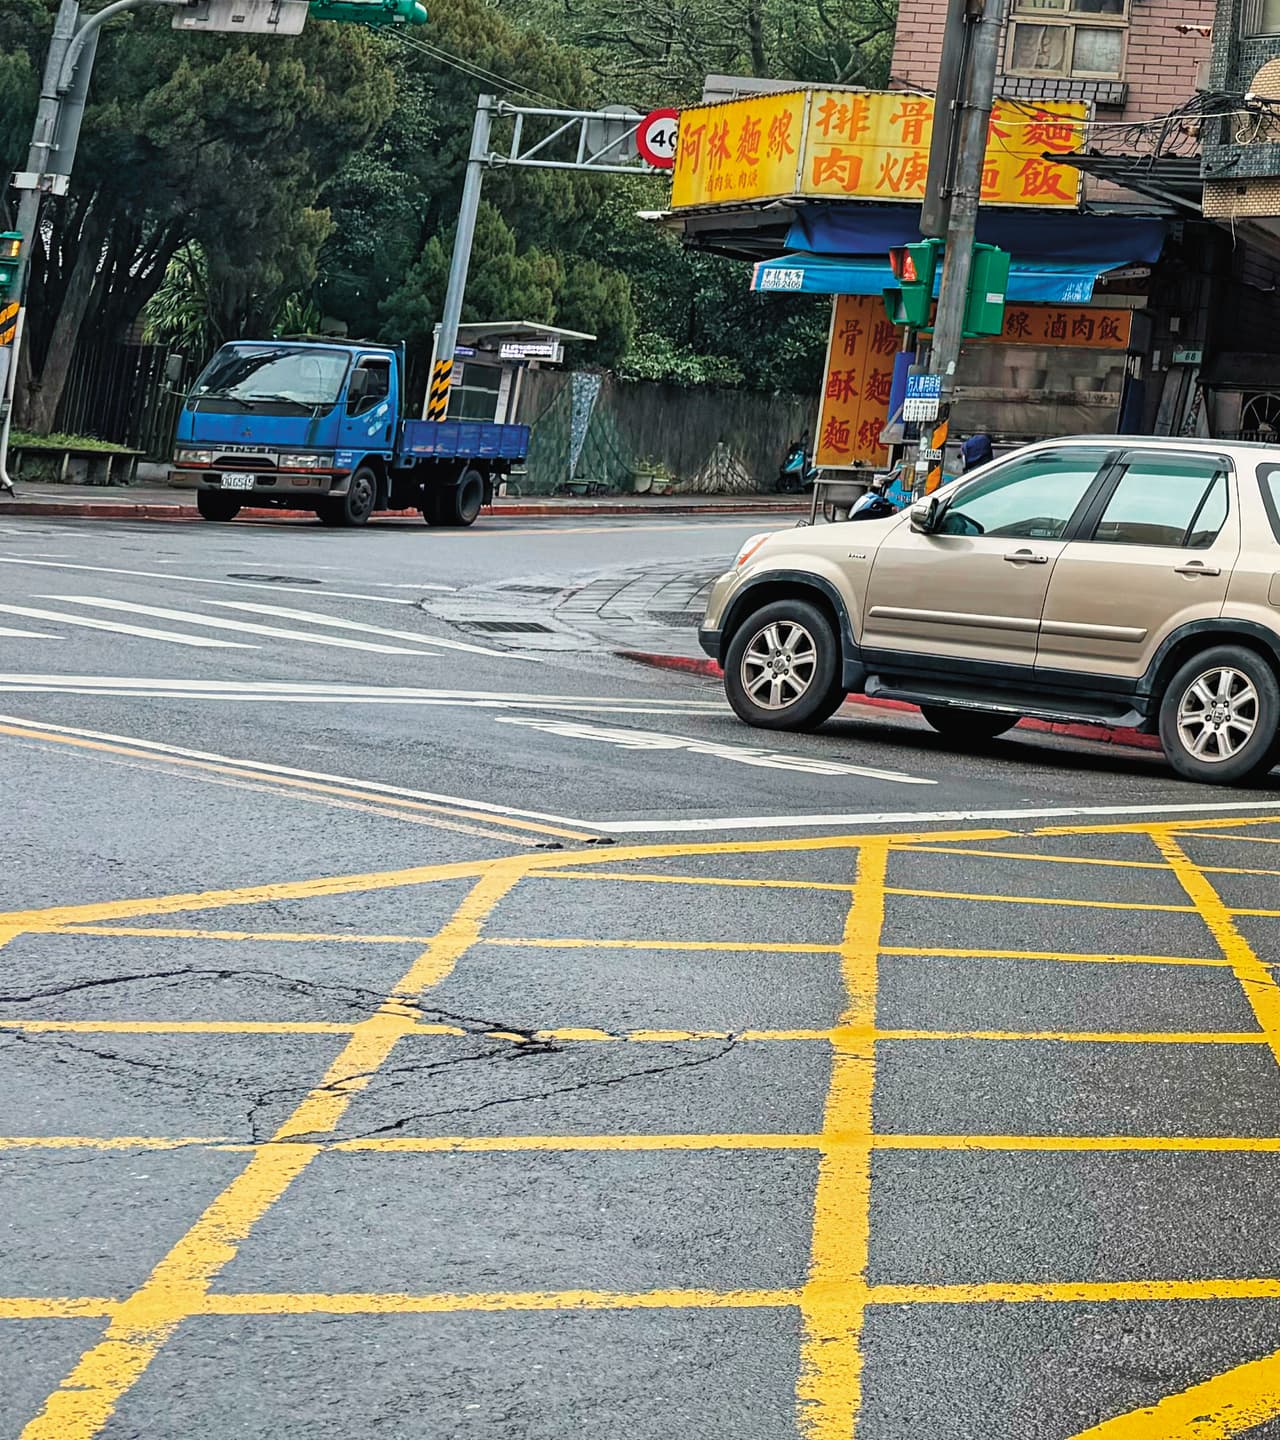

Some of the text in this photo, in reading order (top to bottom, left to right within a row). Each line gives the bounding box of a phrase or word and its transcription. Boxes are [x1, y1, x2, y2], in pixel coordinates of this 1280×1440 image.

[679, 107, 795, 175] 阿林麵線
[815, 97, 1076, 152] 排骨麵
[1044, 312, 1124, 343] 滷肉飯
